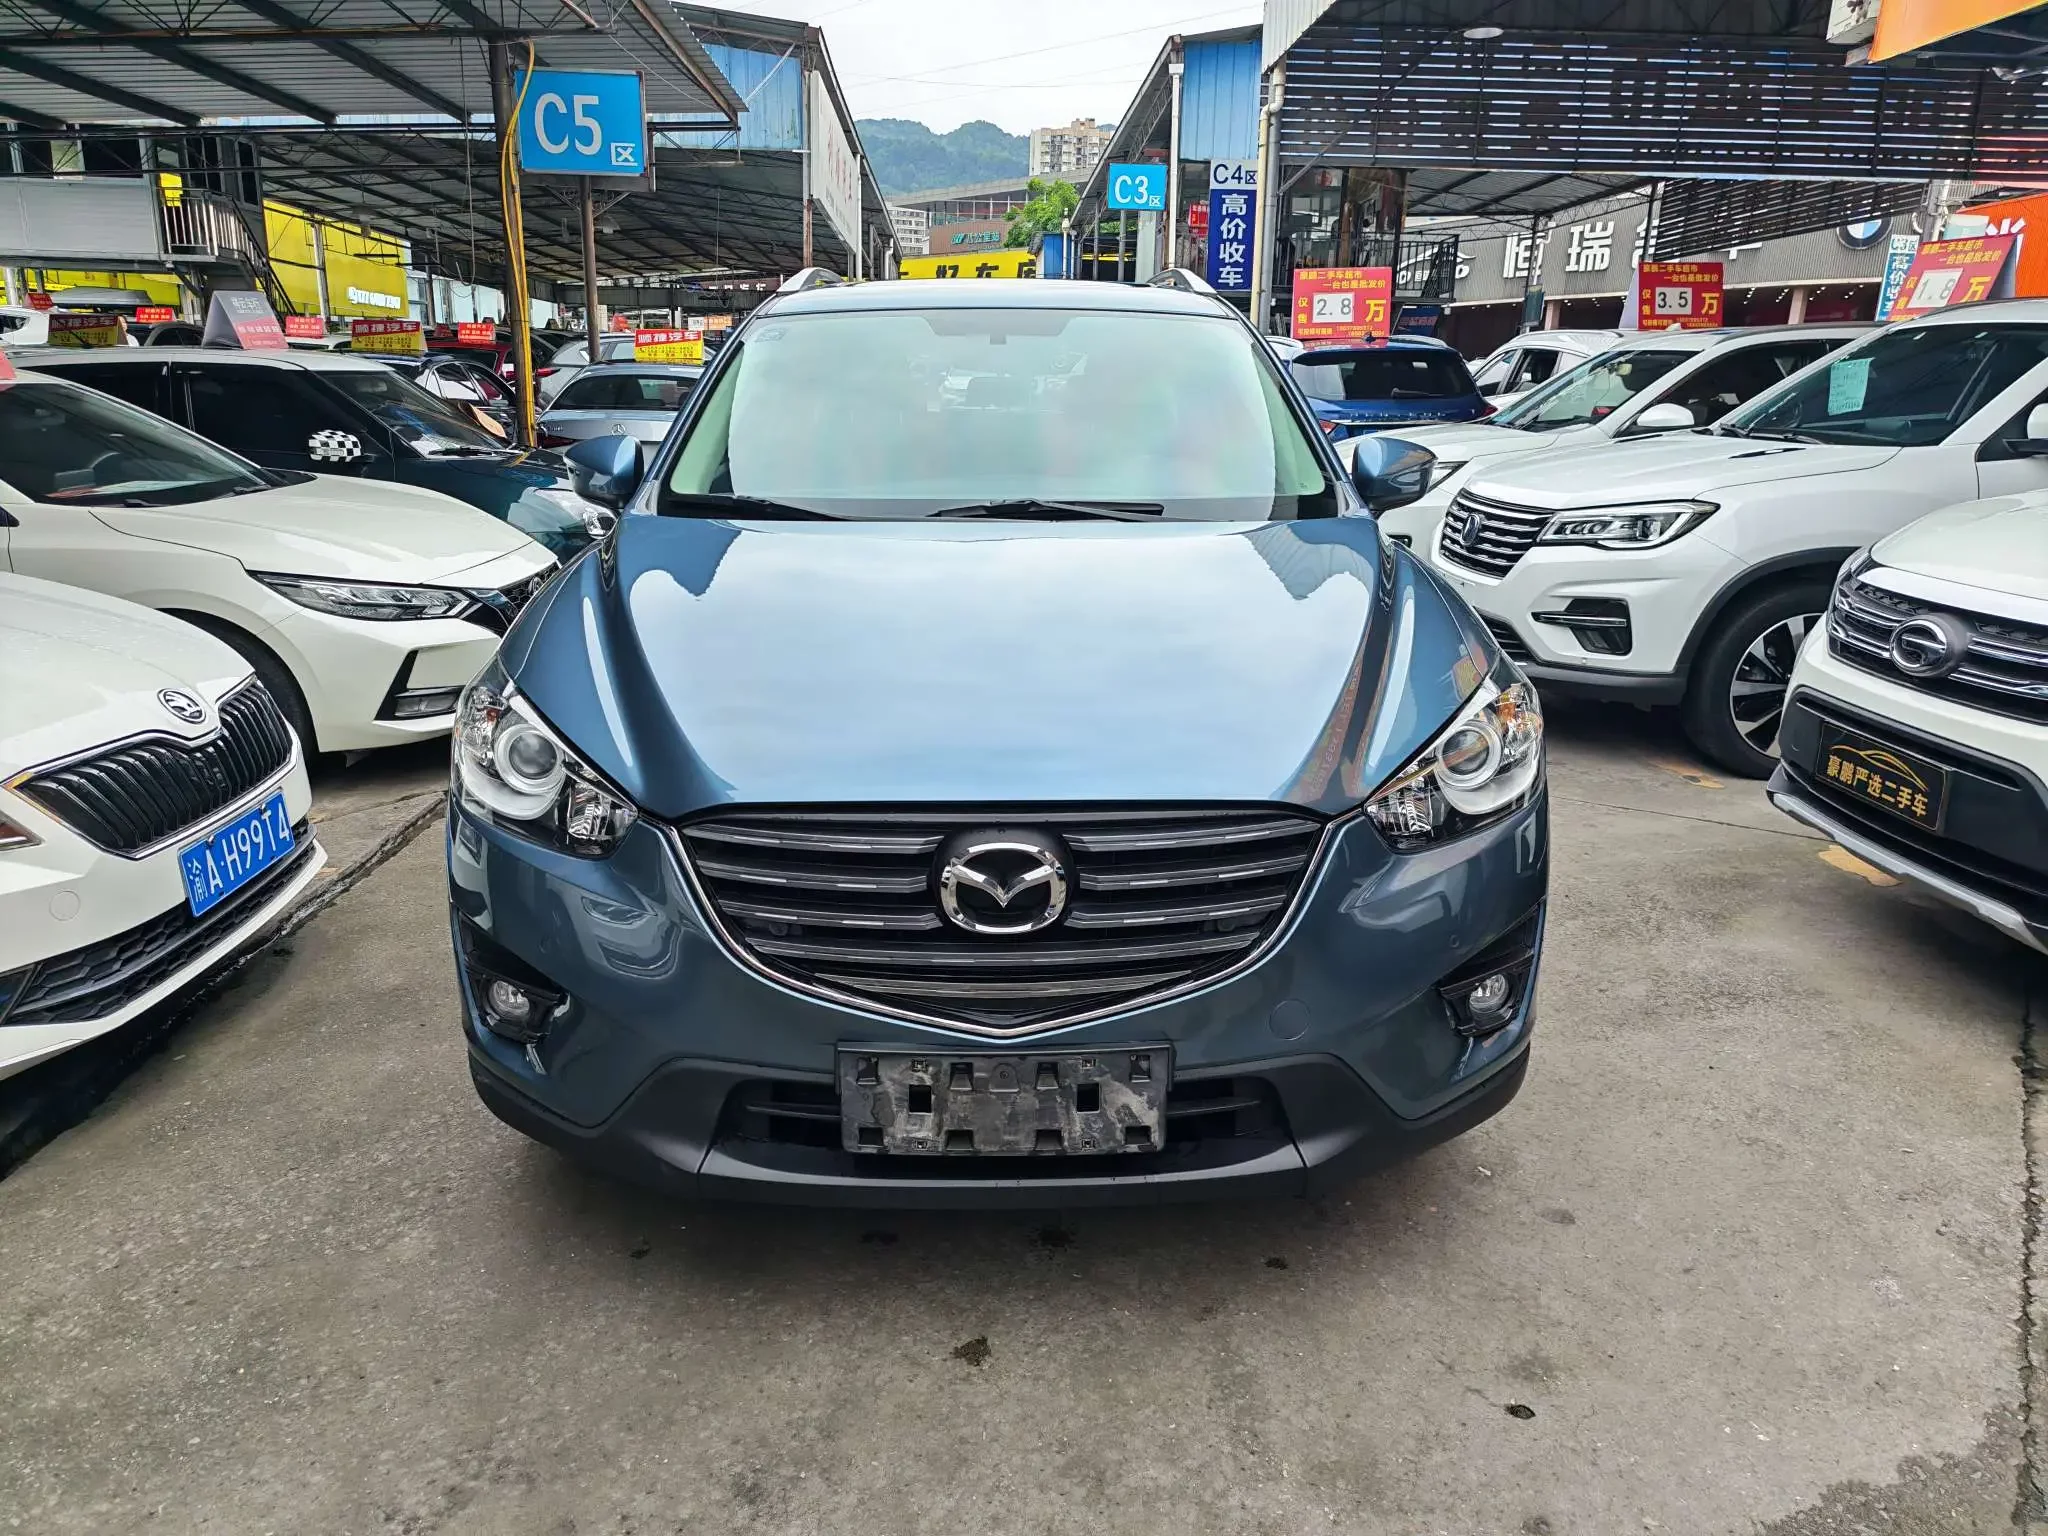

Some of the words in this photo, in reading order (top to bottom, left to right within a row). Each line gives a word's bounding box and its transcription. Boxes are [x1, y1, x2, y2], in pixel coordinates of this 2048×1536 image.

[535, 93, 638, 166] C5区
[1213, 163, 1258, 185] C4区
[1115, 175, 1161, 206] C3区
[1218, 193, 1249, 287] 高价收车
[1701, 292, 1720, 315] 万
[1960, 276, 1993, 304] 万
[1365, 299, 1387, 323] 万
